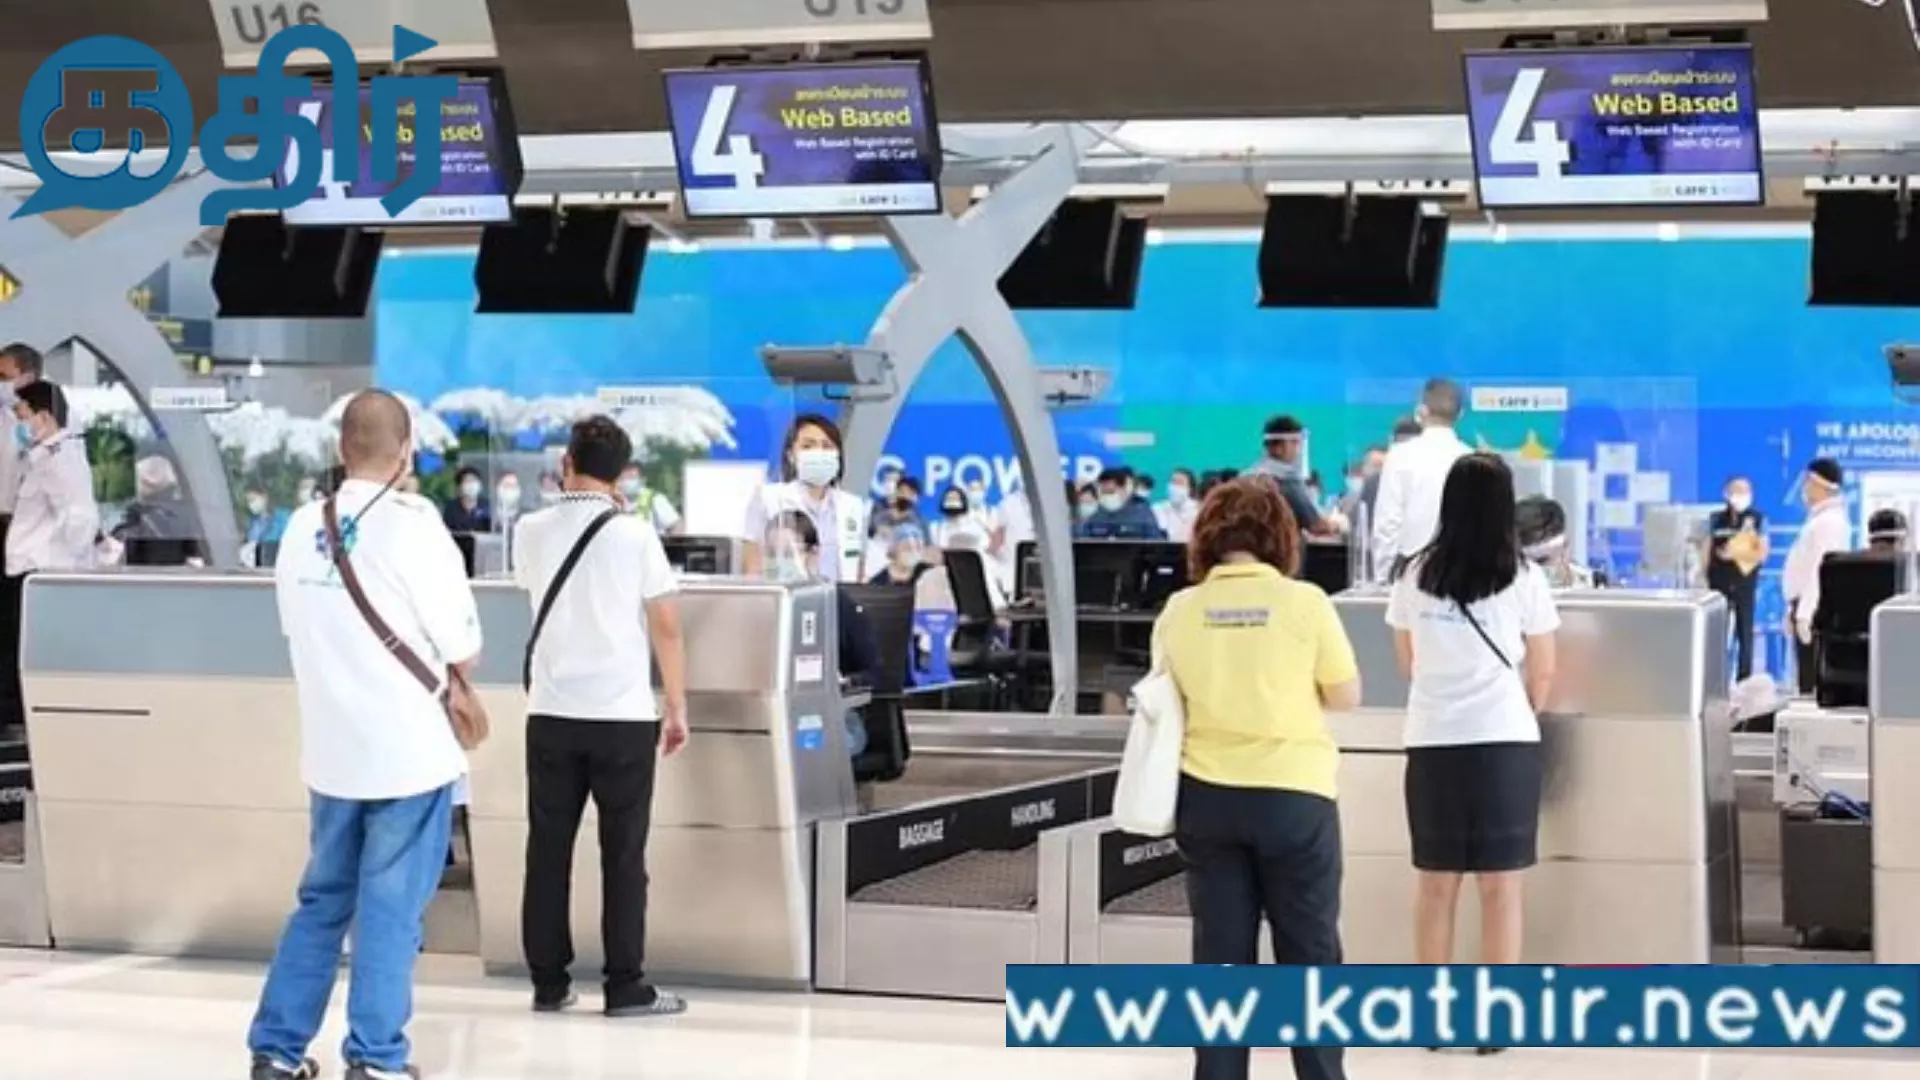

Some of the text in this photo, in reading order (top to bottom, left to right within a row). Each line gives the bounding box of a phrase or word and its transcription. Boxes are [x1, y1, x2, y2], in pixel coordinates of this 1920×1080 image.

[781, 105, 912, 129] Web Based
[1489, 67, 1570, 180] 4
[1593, 90, 1739, 116] Web Based
[691, 85, 764, 191] 4
